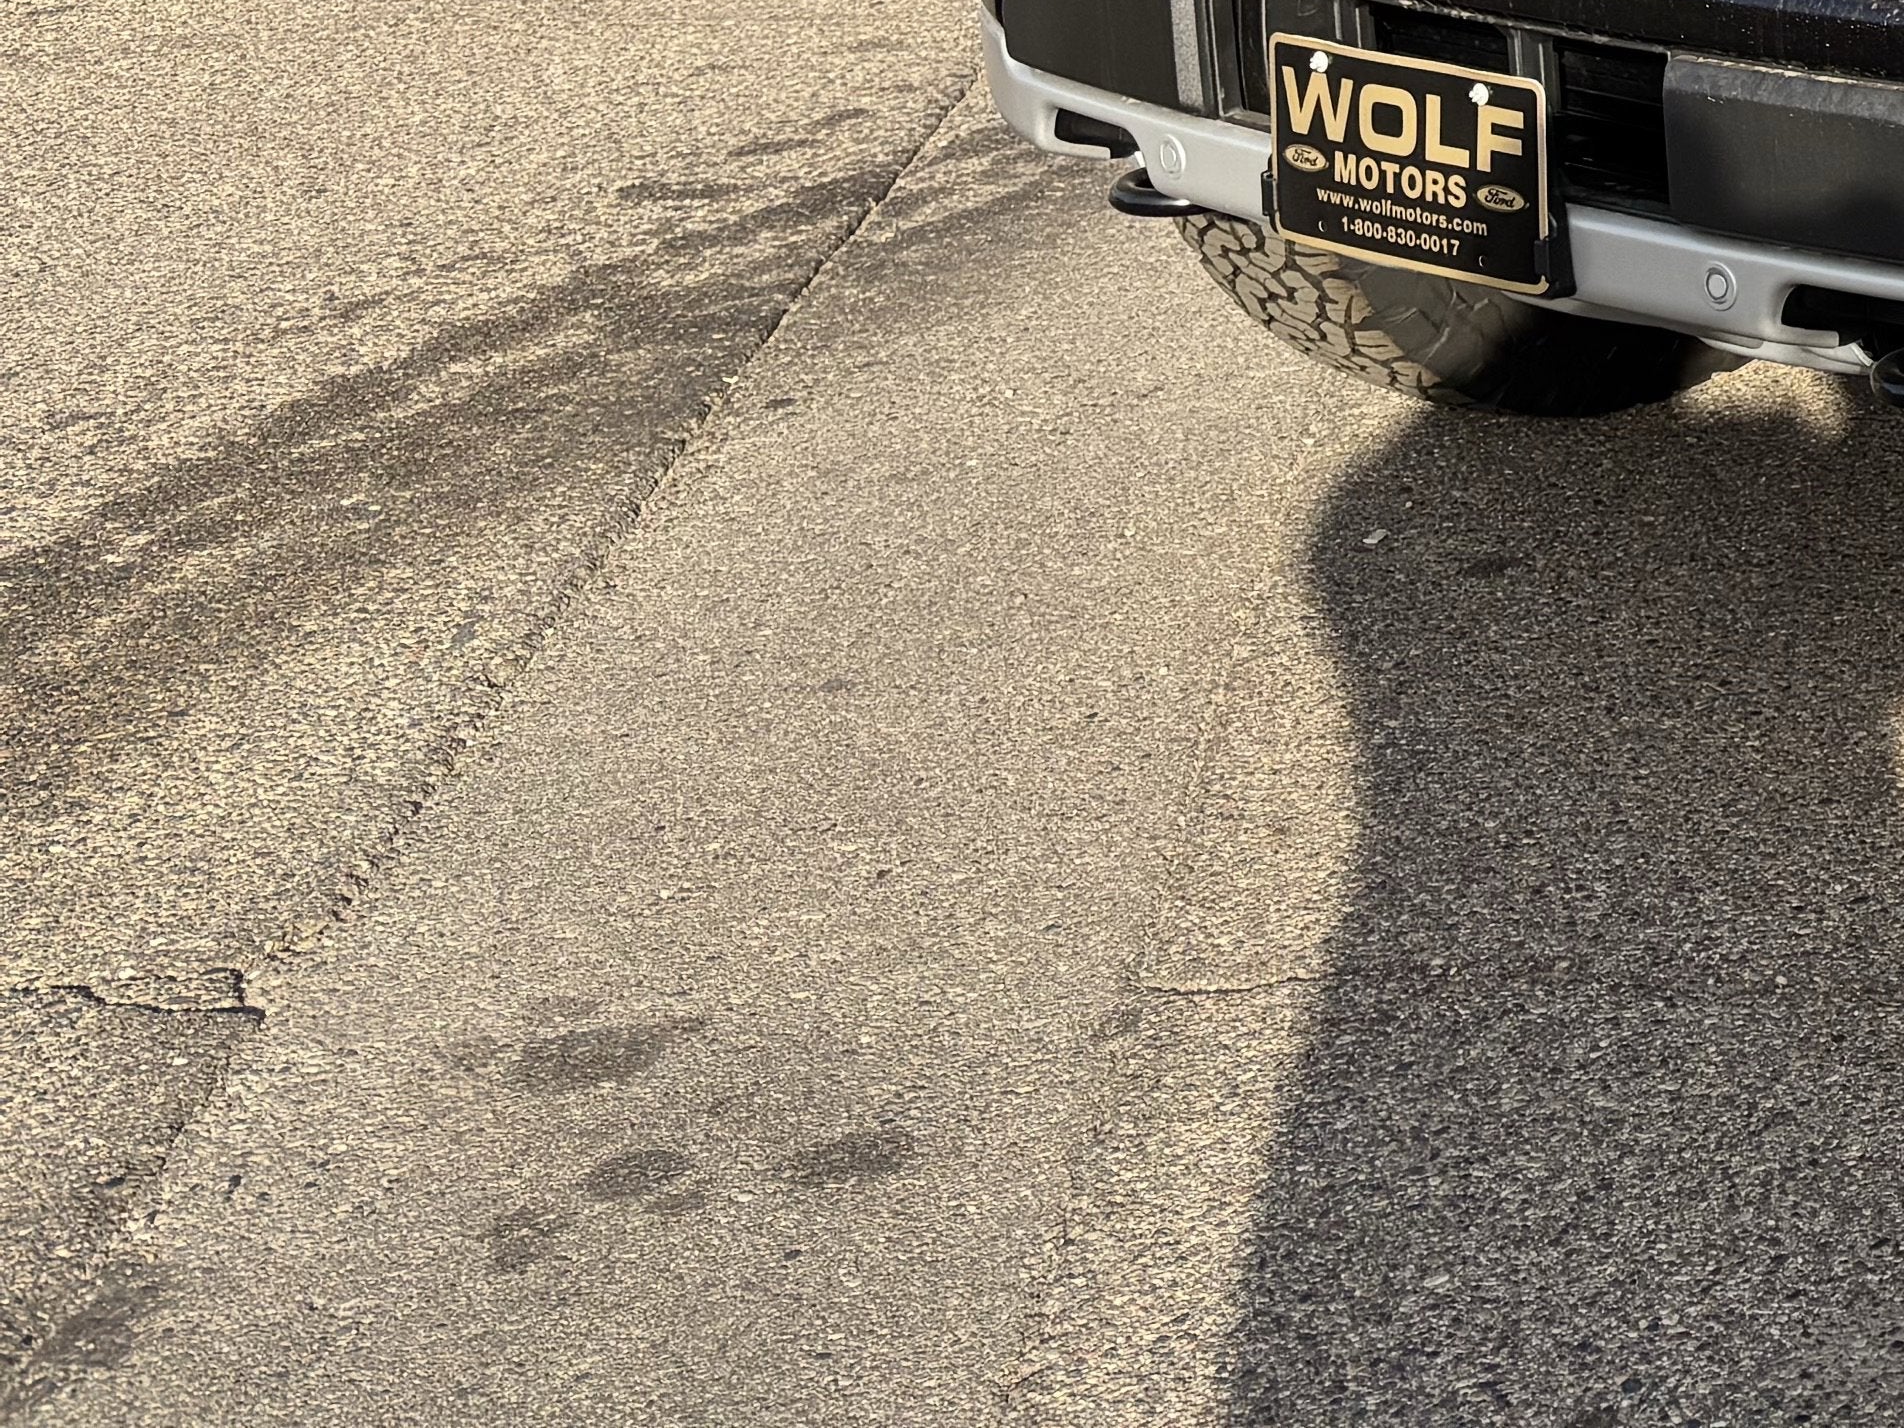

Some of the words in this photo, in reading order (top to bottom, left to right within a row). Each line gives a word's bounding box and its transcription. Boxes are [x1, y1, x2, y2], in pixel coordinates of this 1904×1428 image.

[1281, 65, 1525, 172] WOLF
[1333, 149, 1468, 209] MOTORS
[1316, 187, 1489, 237] www.wolfmotors.com
[1341, 216, 1461, 256] 1-800-830-0017
